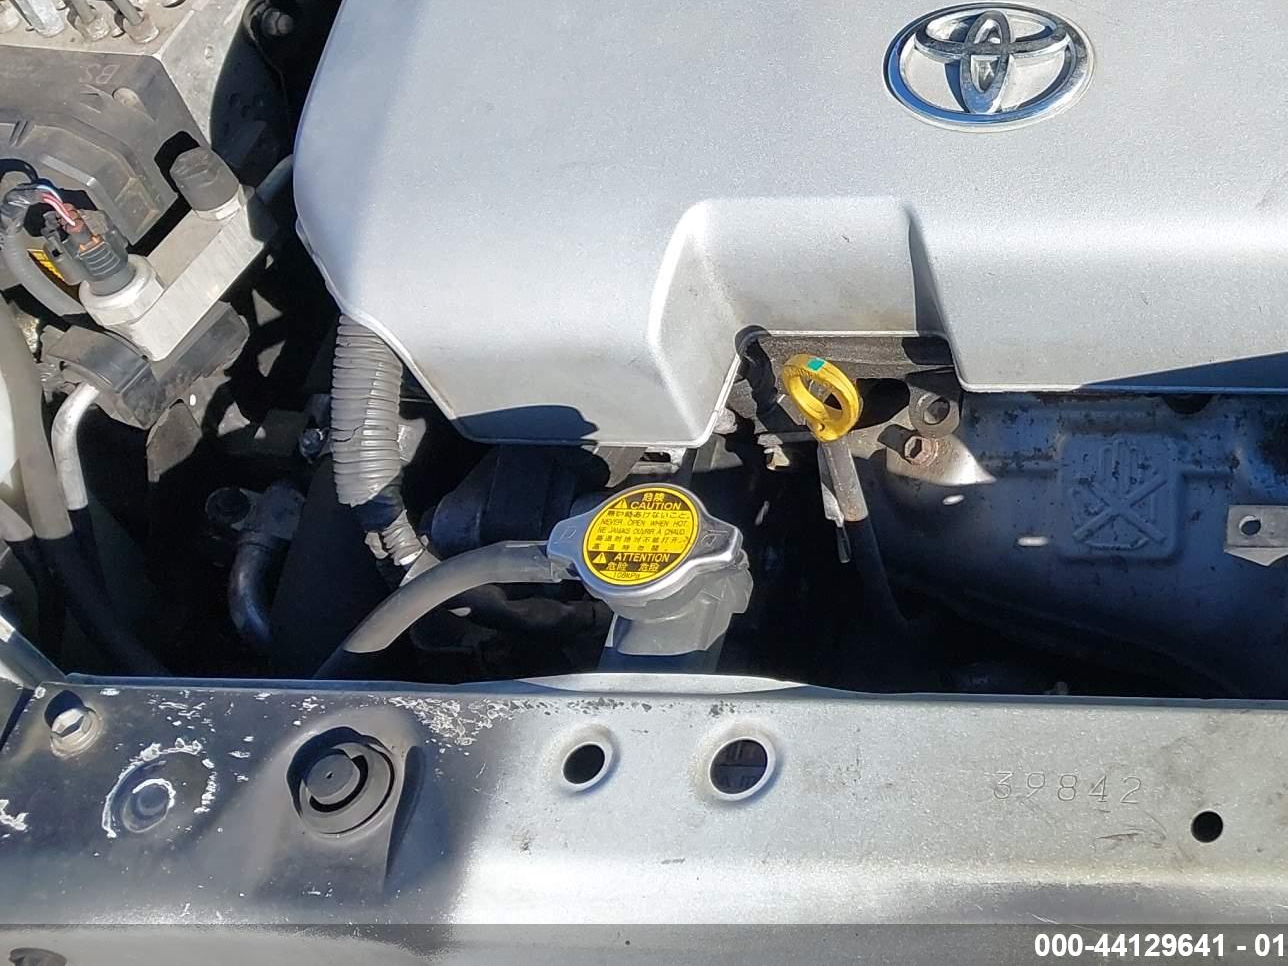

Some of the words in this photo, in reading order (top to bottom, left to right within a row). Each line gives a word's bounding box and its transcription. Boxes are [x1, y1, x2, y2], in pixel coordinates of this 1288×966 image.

[630, 501, 681, 510] CAUTION
[613, 553, 670, 563] ATTENTION
[993, 770, 1142, 804] 39842
